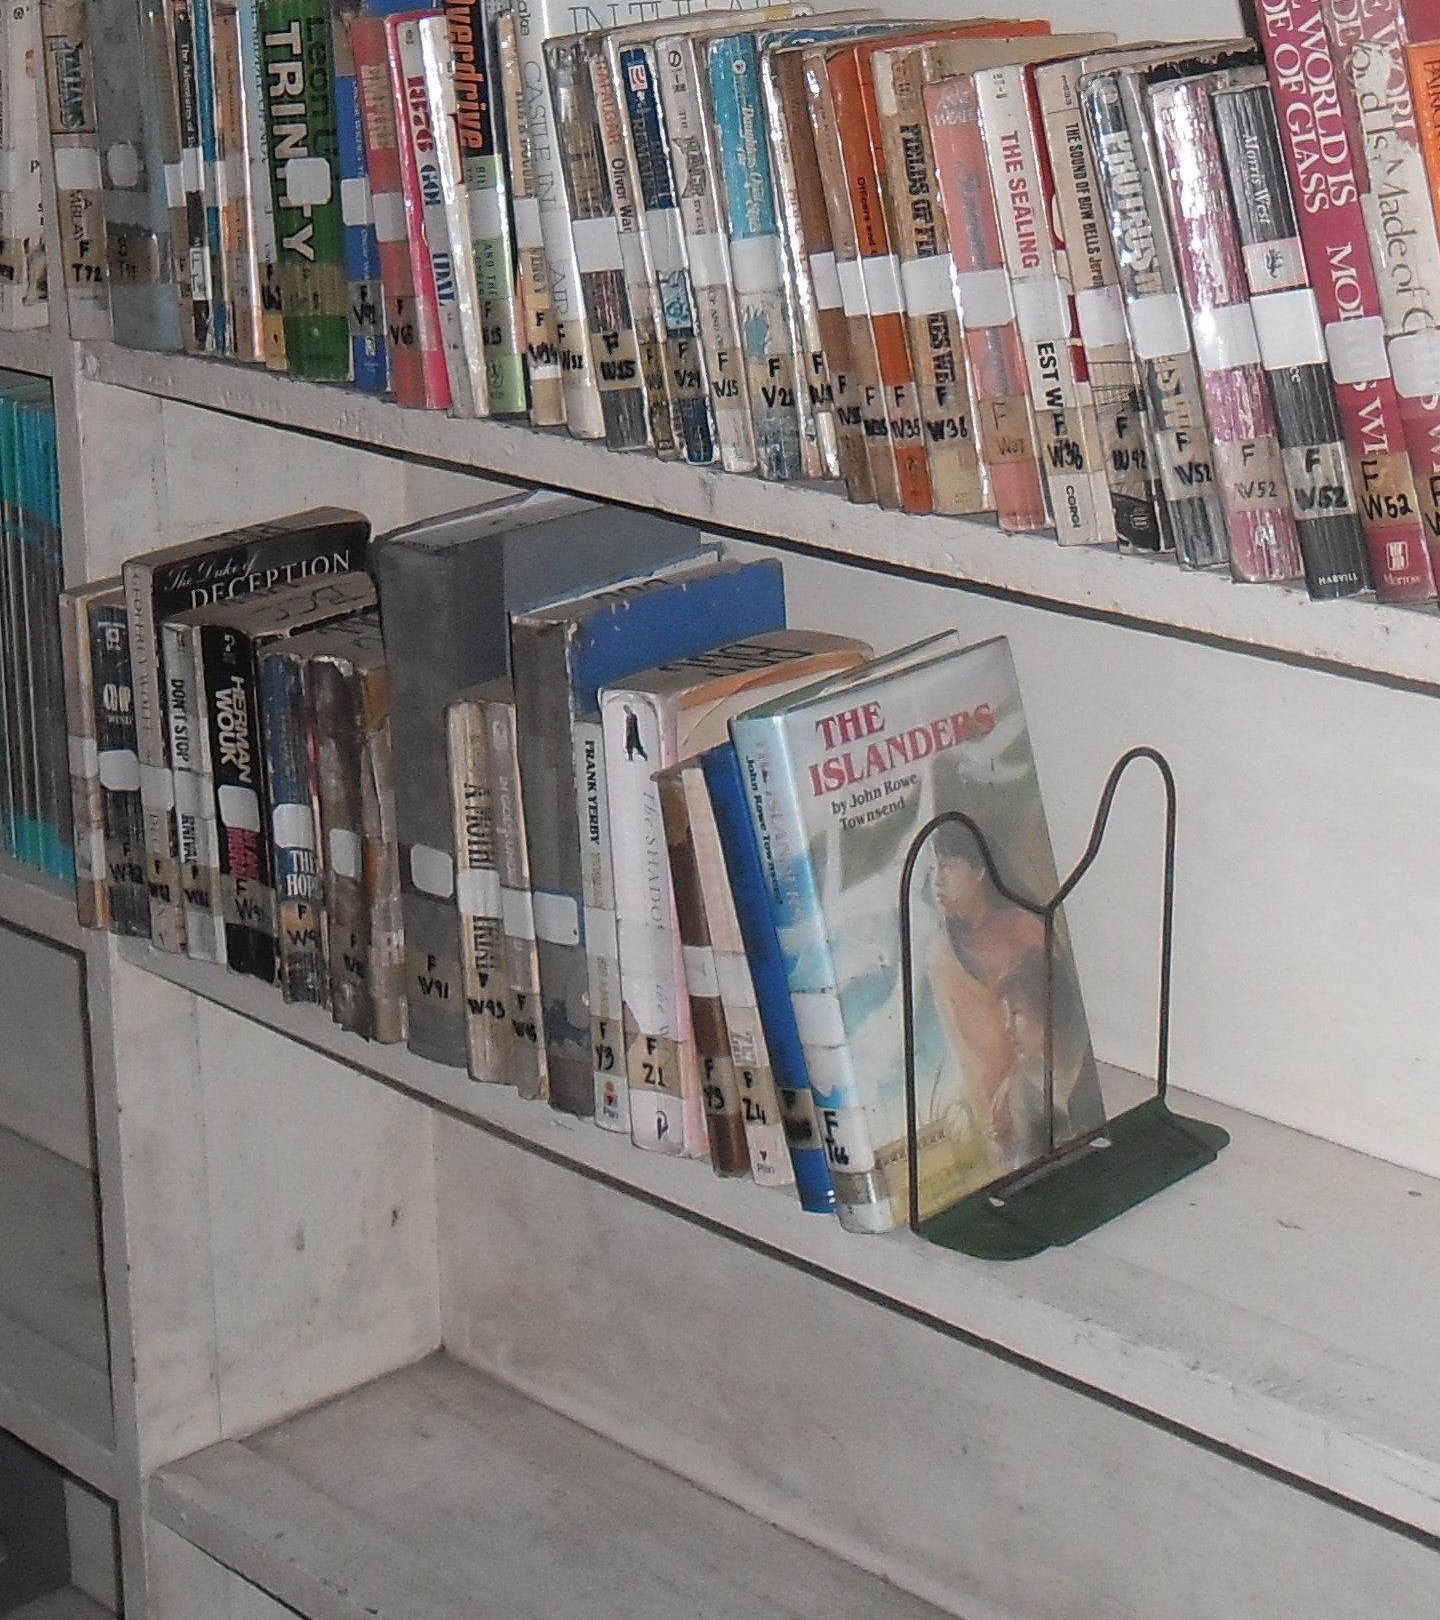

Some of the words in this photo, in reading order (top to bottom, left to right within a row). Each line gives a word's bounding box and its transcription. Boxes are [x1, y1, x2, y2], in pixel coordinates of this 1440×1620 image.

[1272, 42, 1302, 99] OF
[1298, 17, 1346, 165] WORLD
[1329, 167, 1359, 209] IS
[1001, 130, 1019, 174] THE
[1285, 102, 1331, 214] GLASS
[1008, 178, 1040, 270] SEALING
[1064, 485, 1080, 529] CORGI
[190, 550, 350, 610] DECEPTION
[214, 688, 239, 765] WOUK
[231, 675, 253, 783] HERMAN
[809, 703, 996, 797] ISLANDERS
[814, 701, 886, 751] THE
[584, 739, 597, 793] FRANK
[746, 756, 759, 791] John
[588, 795, 601, 846] YERBY
[830, 800, 848, 816] by
[849, 785, 883, 810] John
[883, 773, 918, 797] Rowe
[839, 796, 905, 832] Townsend
